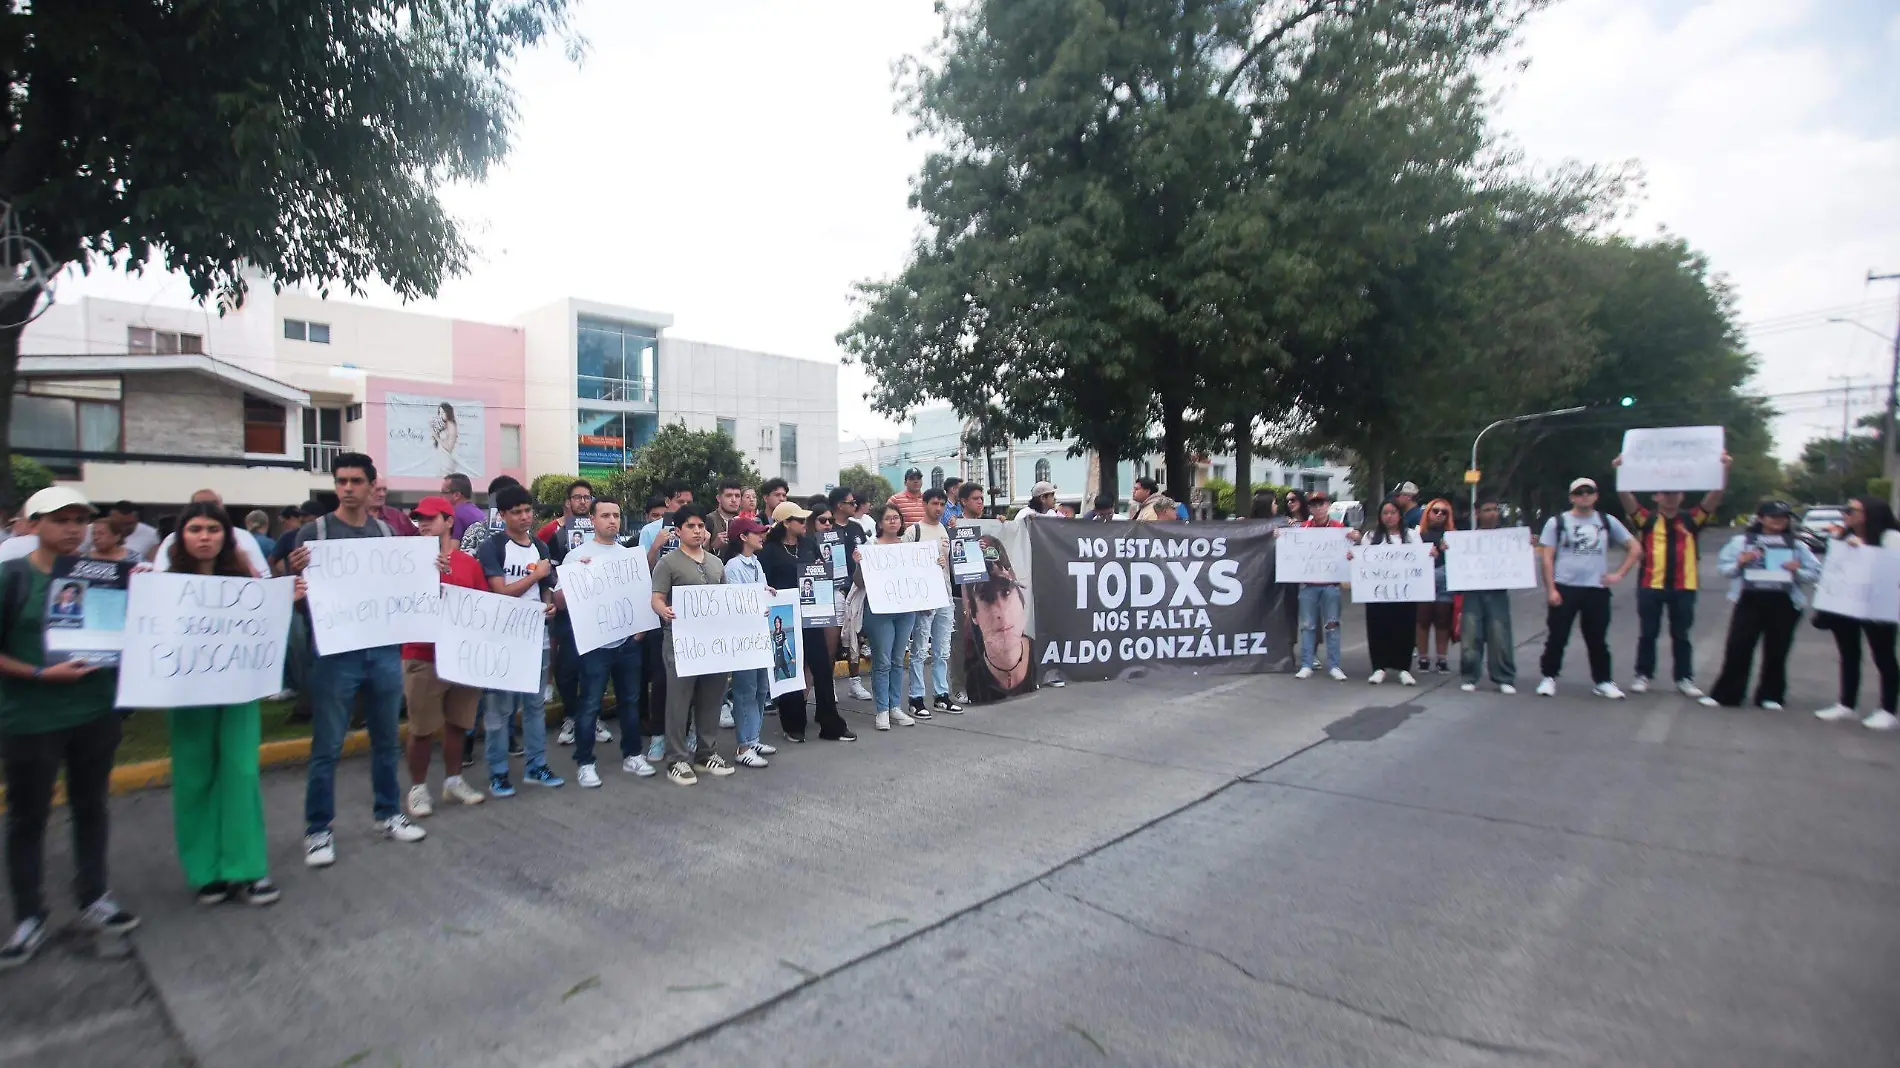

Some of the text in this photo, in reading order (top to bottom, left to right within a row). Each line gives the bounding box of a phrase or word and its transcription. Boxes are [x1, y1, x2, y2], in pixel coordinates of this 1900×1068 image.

[307, 545, 359, 580] Aldo
[864, 547, 898, 572] NOS
[1077, 537, 1227, 559] NO ESTAMOS
[568, 556, 642, 602] NOS FALTA
[884, 576, 929, 605] ALDO
[1067, 559, 1244, 609] TODXS
[176, 579, 266, 612] ALDO
[356, 598, 380, 623] en
[440, 587, 487, 630] NOS
[683, 588, 720, 620] NOS
[136, 614, 268, 637] TE SEGUIMOS
[596, 596, 634, 636] ALDO
[1093, 608, 1213, 632] NOS FALTA
[148, 638, 278, 679] BUSCANDO
[674, 635, 707, 661] Aldo
[712, 637, 728, 656] en
[1040, 628, 1268, 664] ALDO GONZÁLEZ
